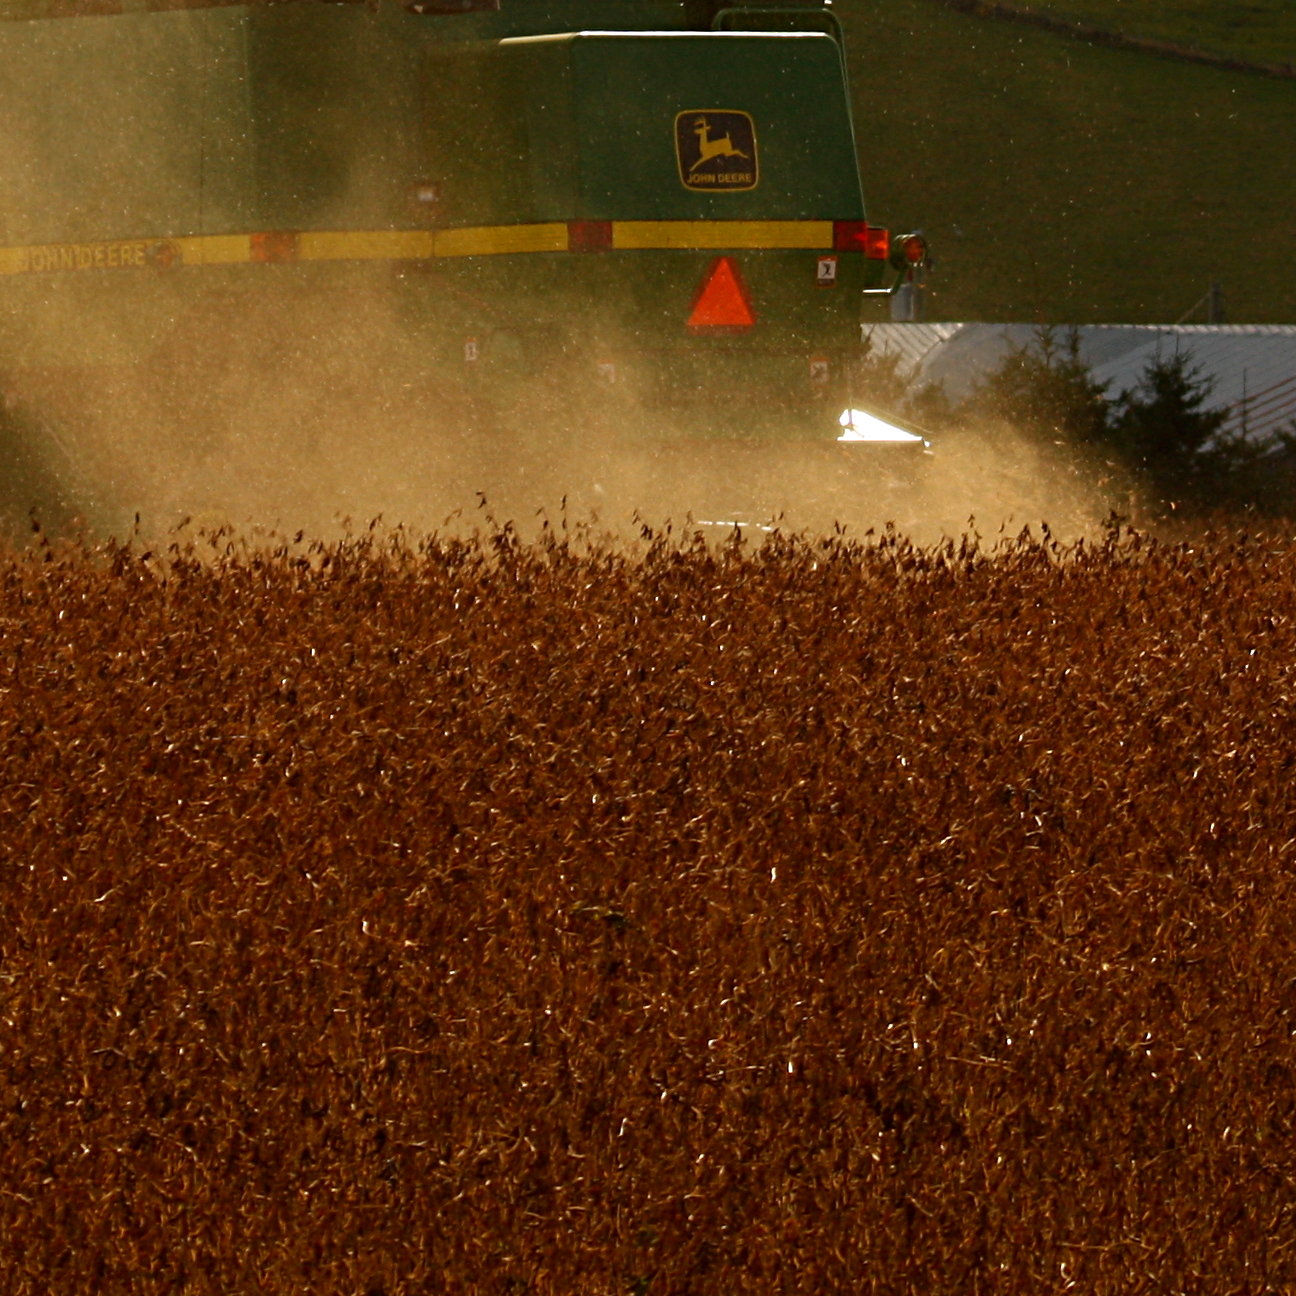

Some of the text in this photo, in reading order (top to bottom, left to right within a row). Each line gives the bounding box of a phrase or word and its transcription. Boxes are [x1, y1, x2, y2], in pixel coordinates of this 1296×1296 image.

[687, 172, 752, 184] JOHN DEERE
[18, 242, 147, 272] JOHN DEERE
